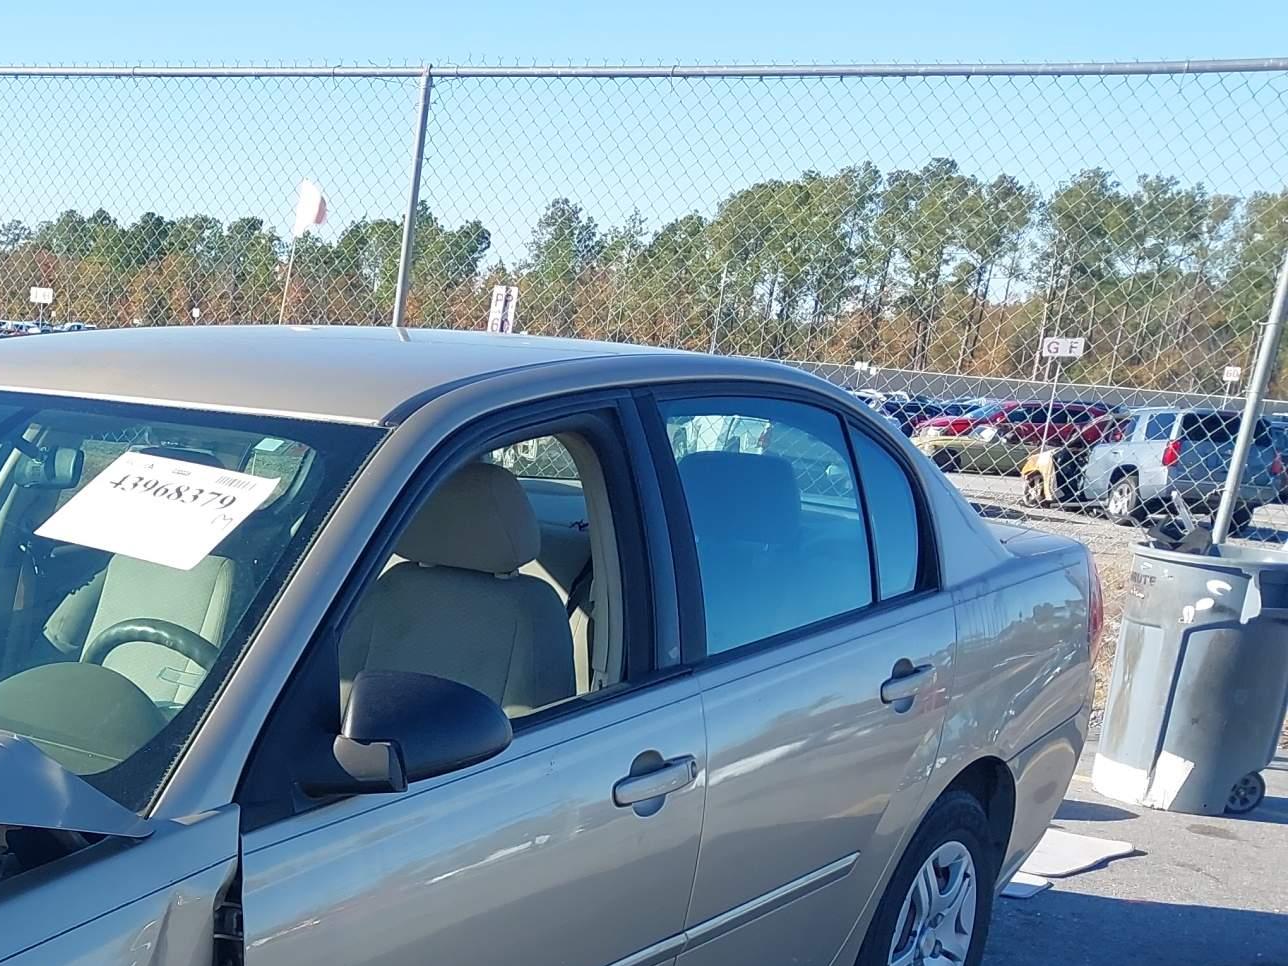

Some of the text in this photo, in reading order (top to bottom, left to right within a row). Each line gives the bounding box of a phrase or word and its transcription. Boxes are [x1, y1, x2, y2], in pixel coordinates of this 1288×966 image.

[1047, 341, 1079, 354] G F
[109, 474, 237, 510] 43968379
